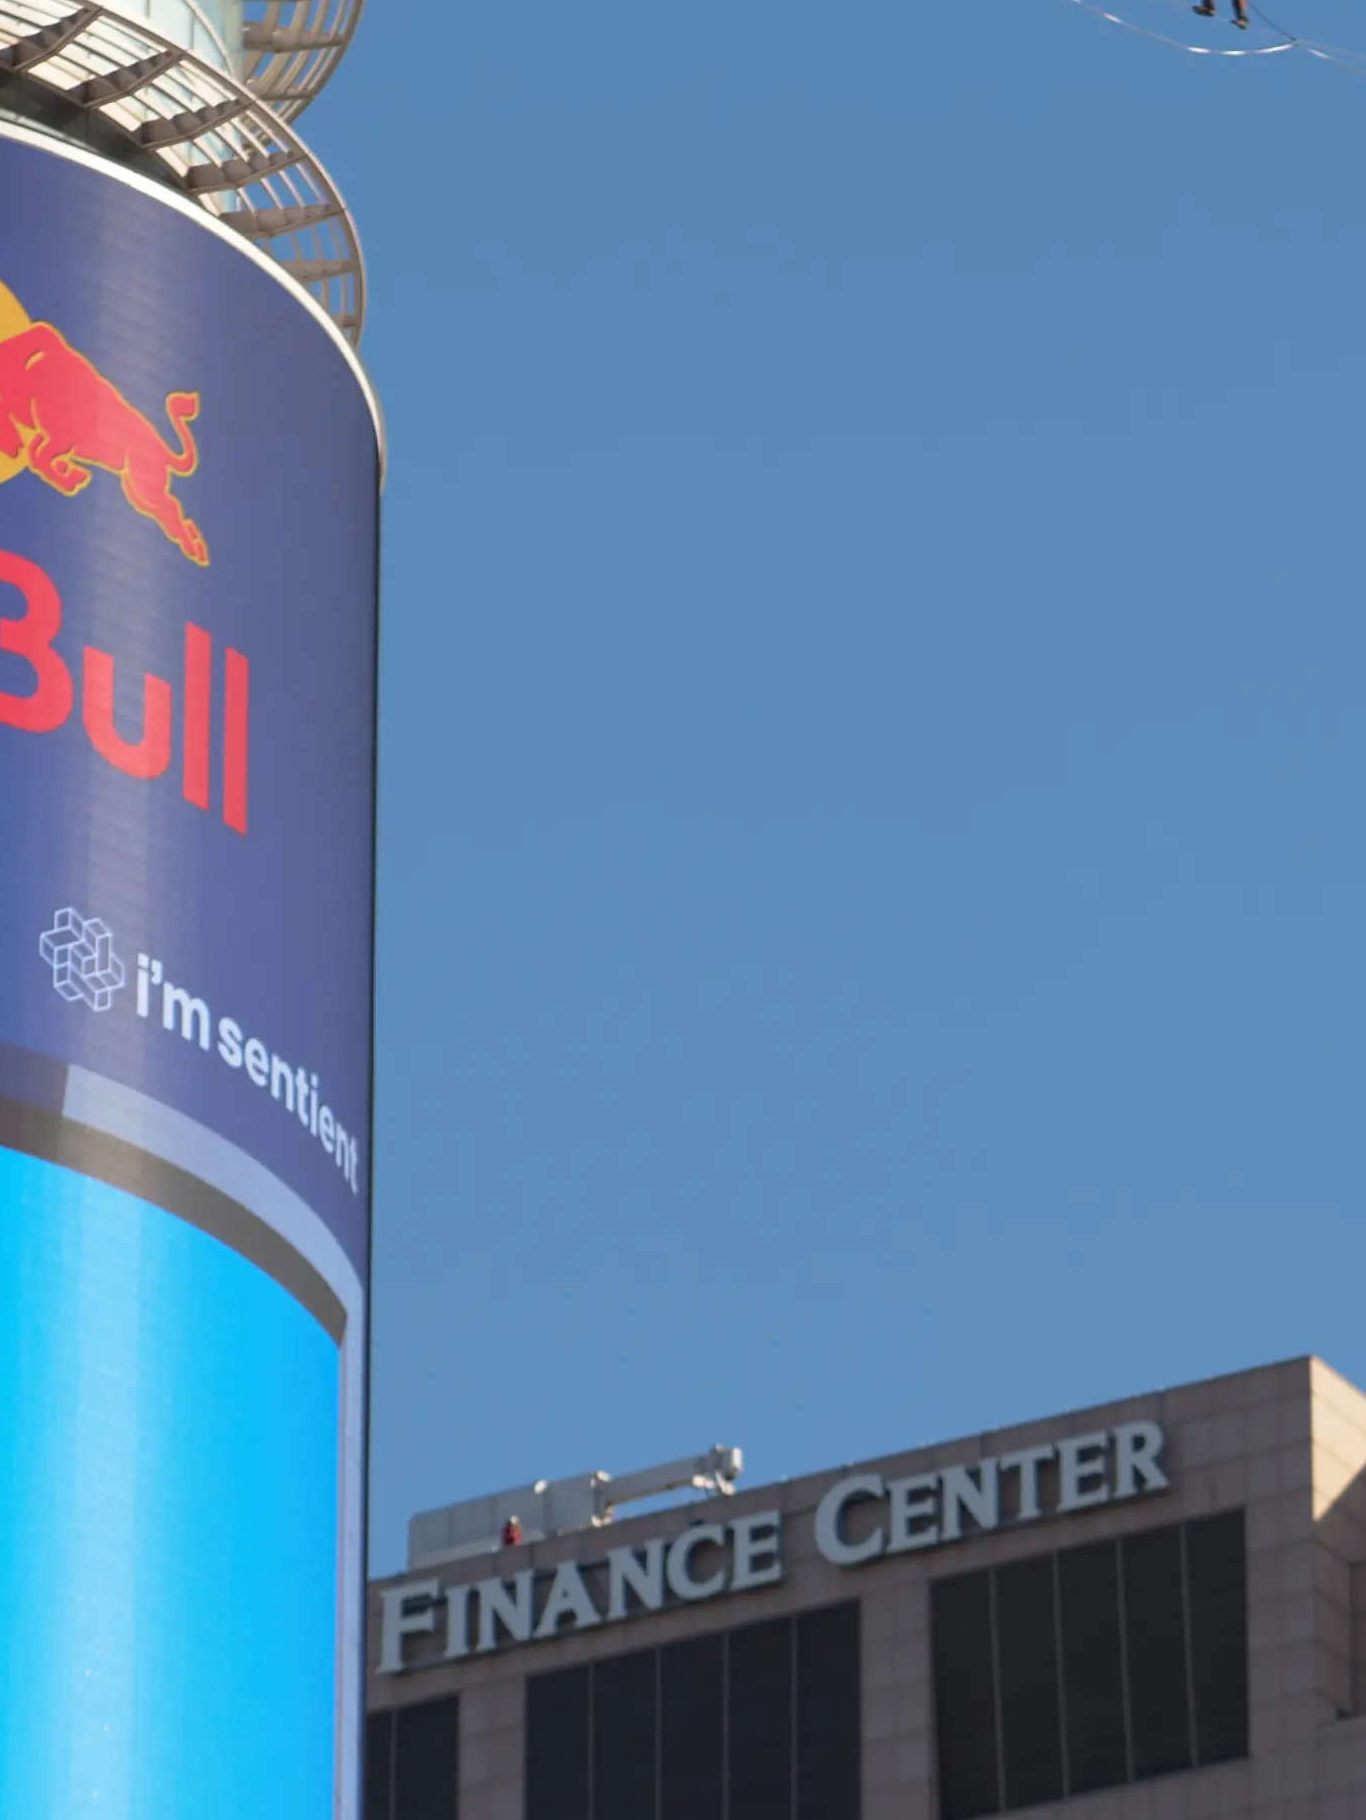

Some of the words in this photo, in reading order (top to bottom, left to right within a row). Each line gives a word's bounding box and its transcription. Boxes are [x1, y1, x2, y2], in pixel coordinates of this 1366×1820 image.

[136, 951, 211, 1052] i'm
[217, 1016, 360, 1198] sentient
[373, 1508, 784, 1675] FINANCE
[813, 1419, 1171, 1567] CENTER
